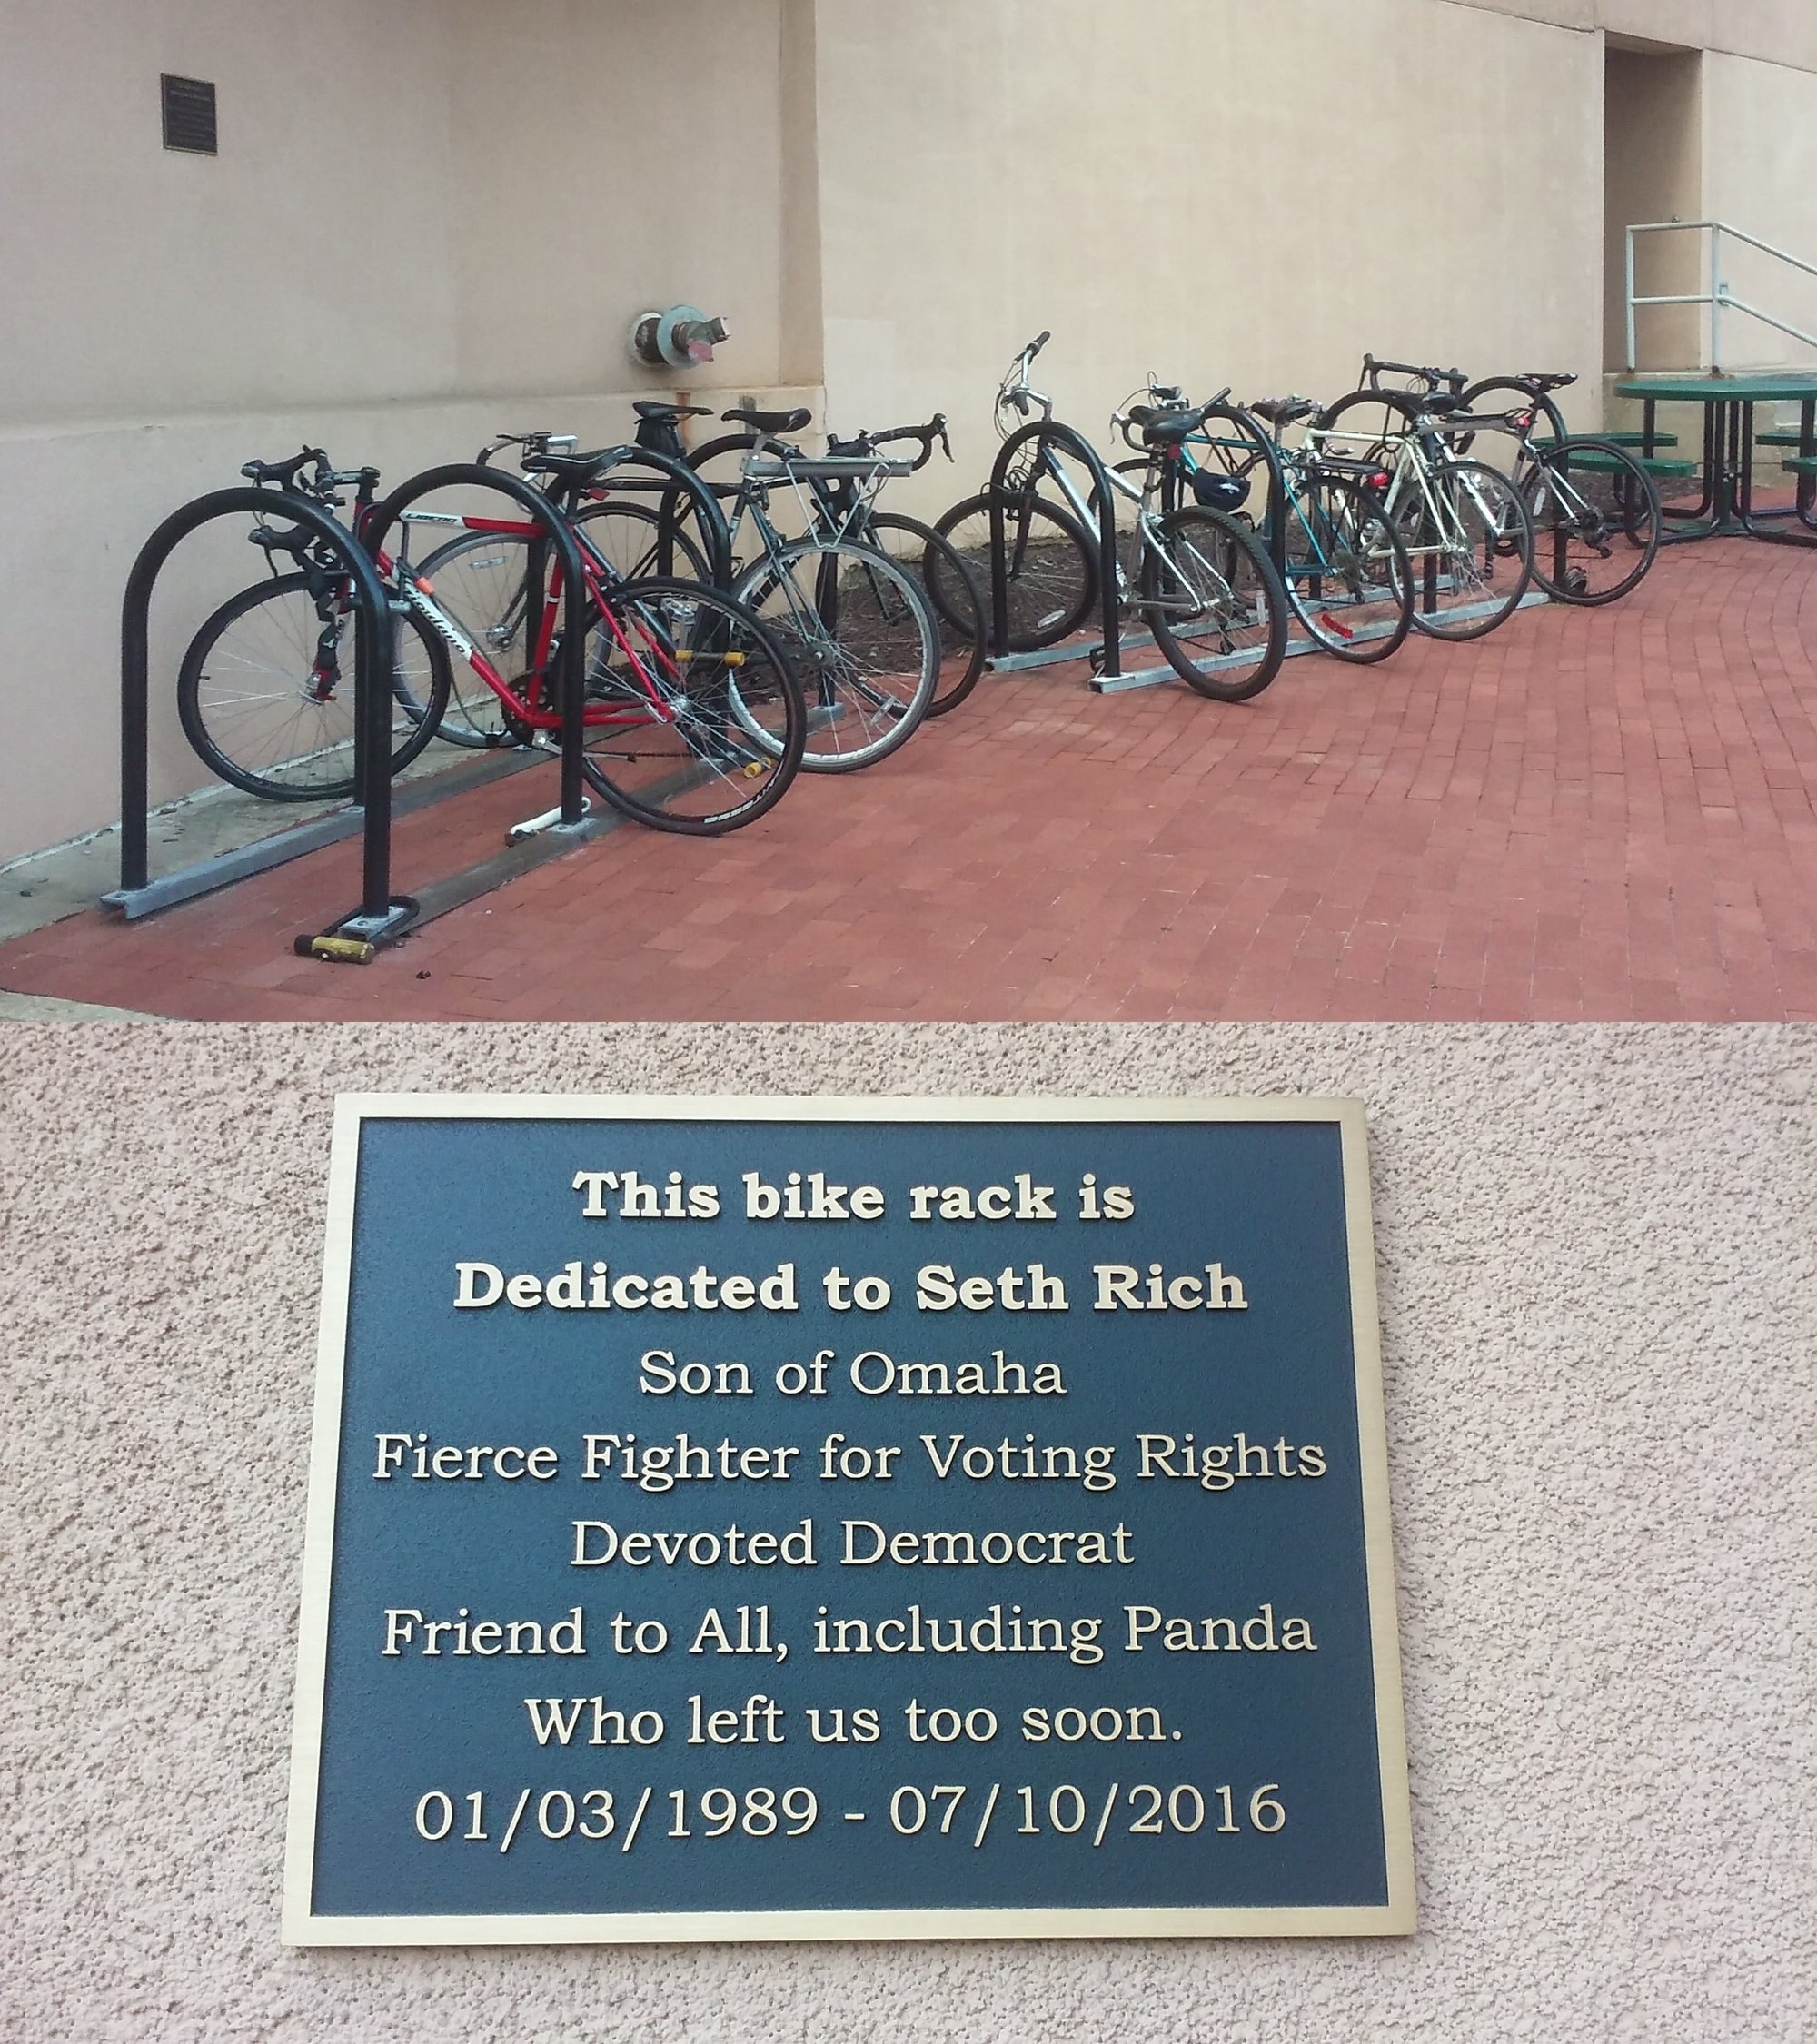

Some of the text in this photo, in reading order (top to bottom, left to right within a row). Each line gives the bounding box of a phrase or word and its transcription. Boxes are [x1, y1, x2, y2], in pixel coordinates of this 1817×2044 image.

[571, 1171, 1134, 1219] This bike rack is
[453, 1261, 1247, 1311] Dedicated to Seth Rich
[640, 1350, 1067, 1394] Son of Omaha
[372, 1433, 1326, 1492] Fierce Fighter for Voting Rights
[571, 1519, 1134, 1565] Devoted Democrat
[382, 1603, 1317, 1665] Friend to All, including Panda
[524, 1695, 1184, 1745] Who left us too soon.
[415, 1786, 818, 1853] 01/03/1989
[889, 1783, 1286, 1848] 07/10/2016
